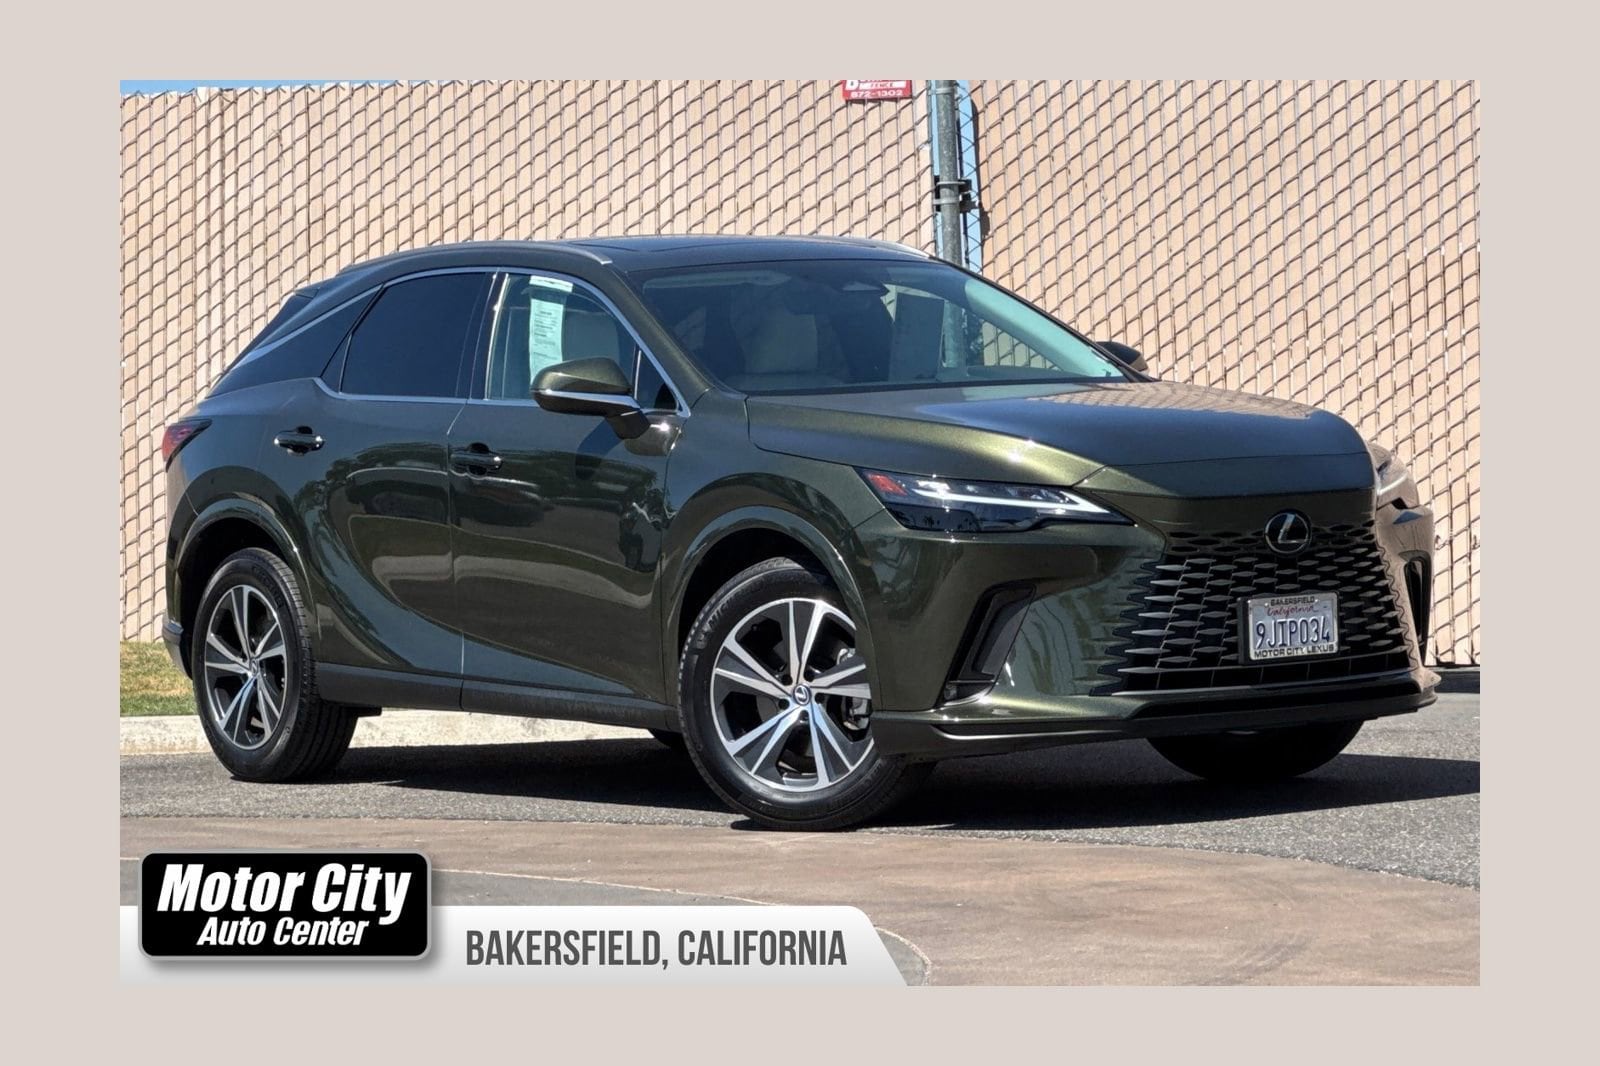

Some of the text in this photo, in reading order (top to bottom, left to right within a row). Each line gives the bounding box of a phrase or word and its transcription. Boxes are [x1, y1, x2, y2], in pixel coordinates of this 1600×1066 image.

[1270, 596, 1315, 606] BAKERSFIELD
[1255, 616, 1330, 650] 9JIP034
[1254, 643, 1335, 658] MOTOR CITY LEXUS
